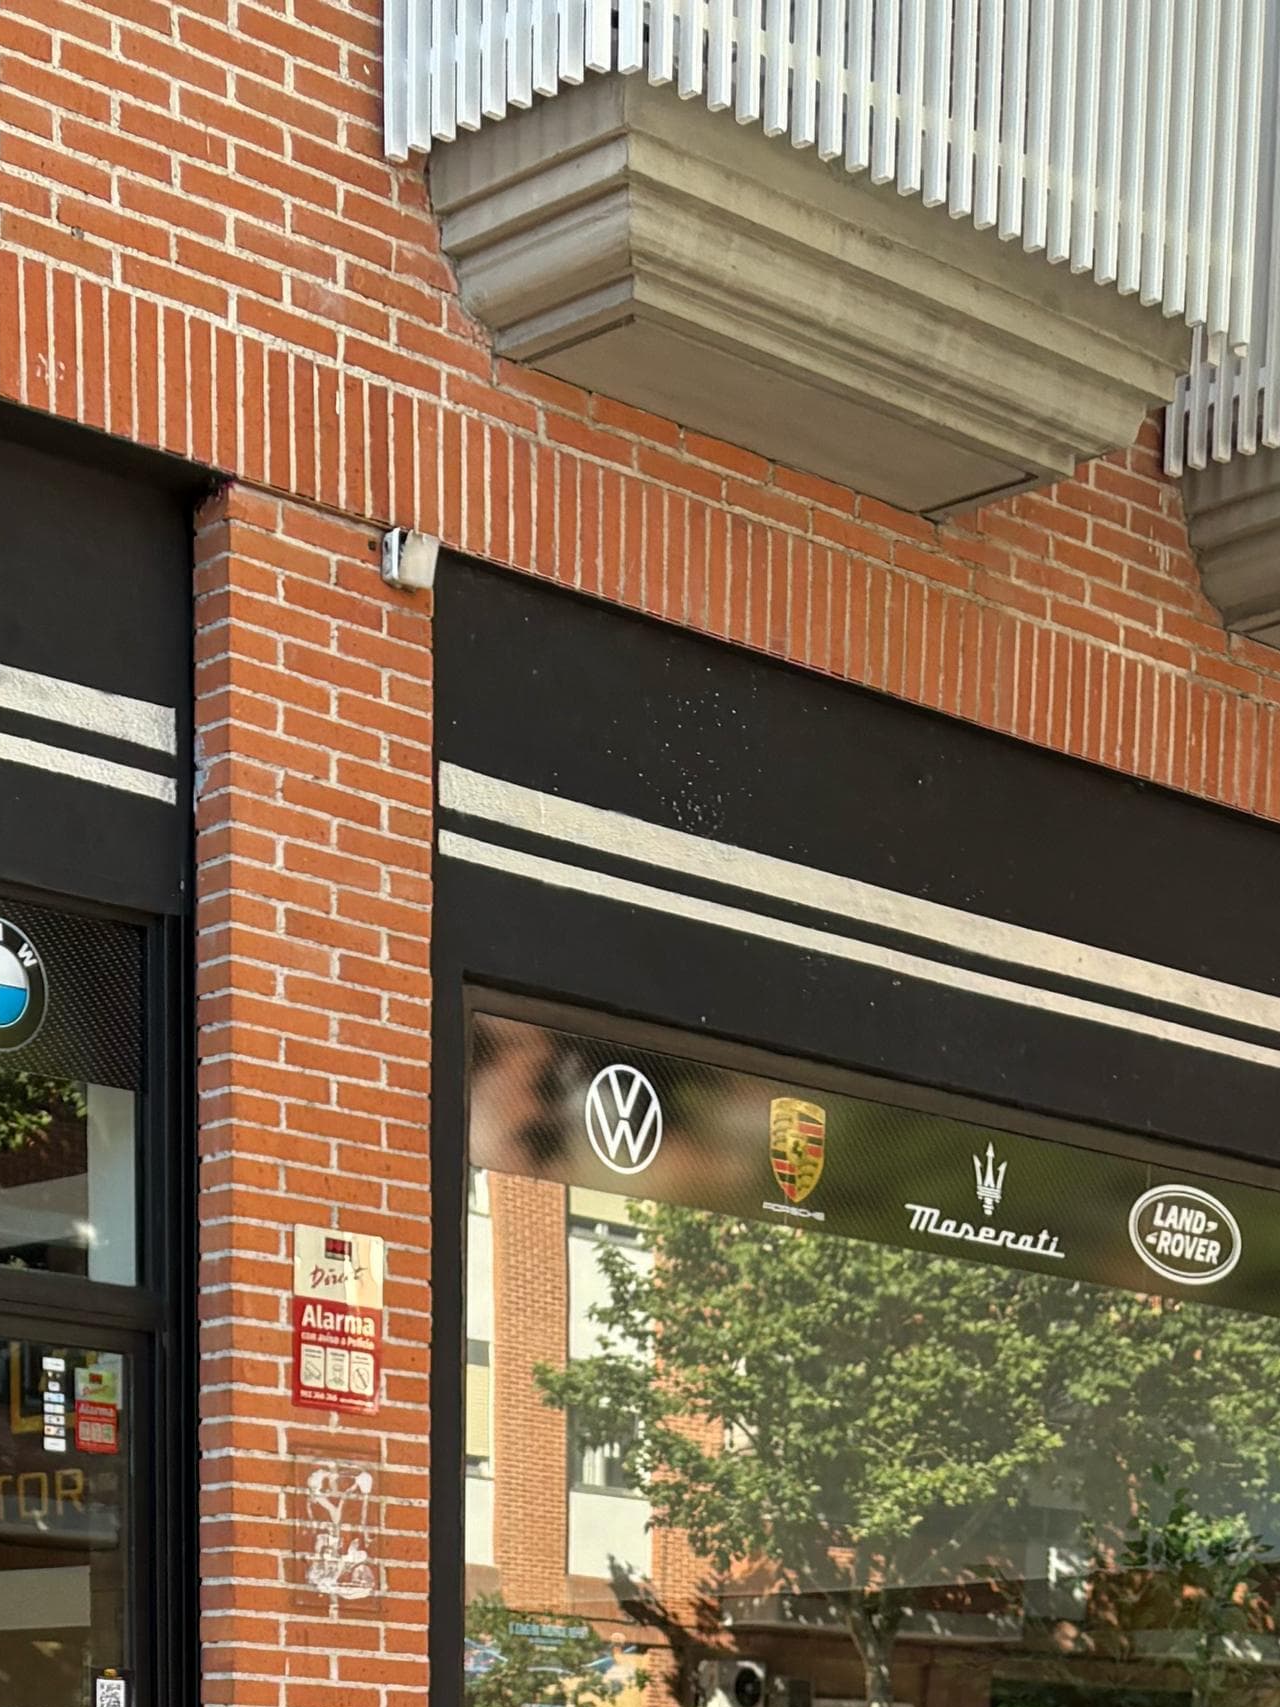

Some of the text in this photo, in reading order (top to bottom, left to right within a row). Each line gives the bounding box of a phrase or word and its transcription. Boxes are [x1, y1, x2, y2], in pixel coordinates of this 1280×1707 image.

[904, 1203, 1066, 1258] Maserati
[1153, 1202, 1208, 1235] LAND
[1154, 1231, 1221, 1265] ROVER
[301, 1304, 375, 1337] Alarma
